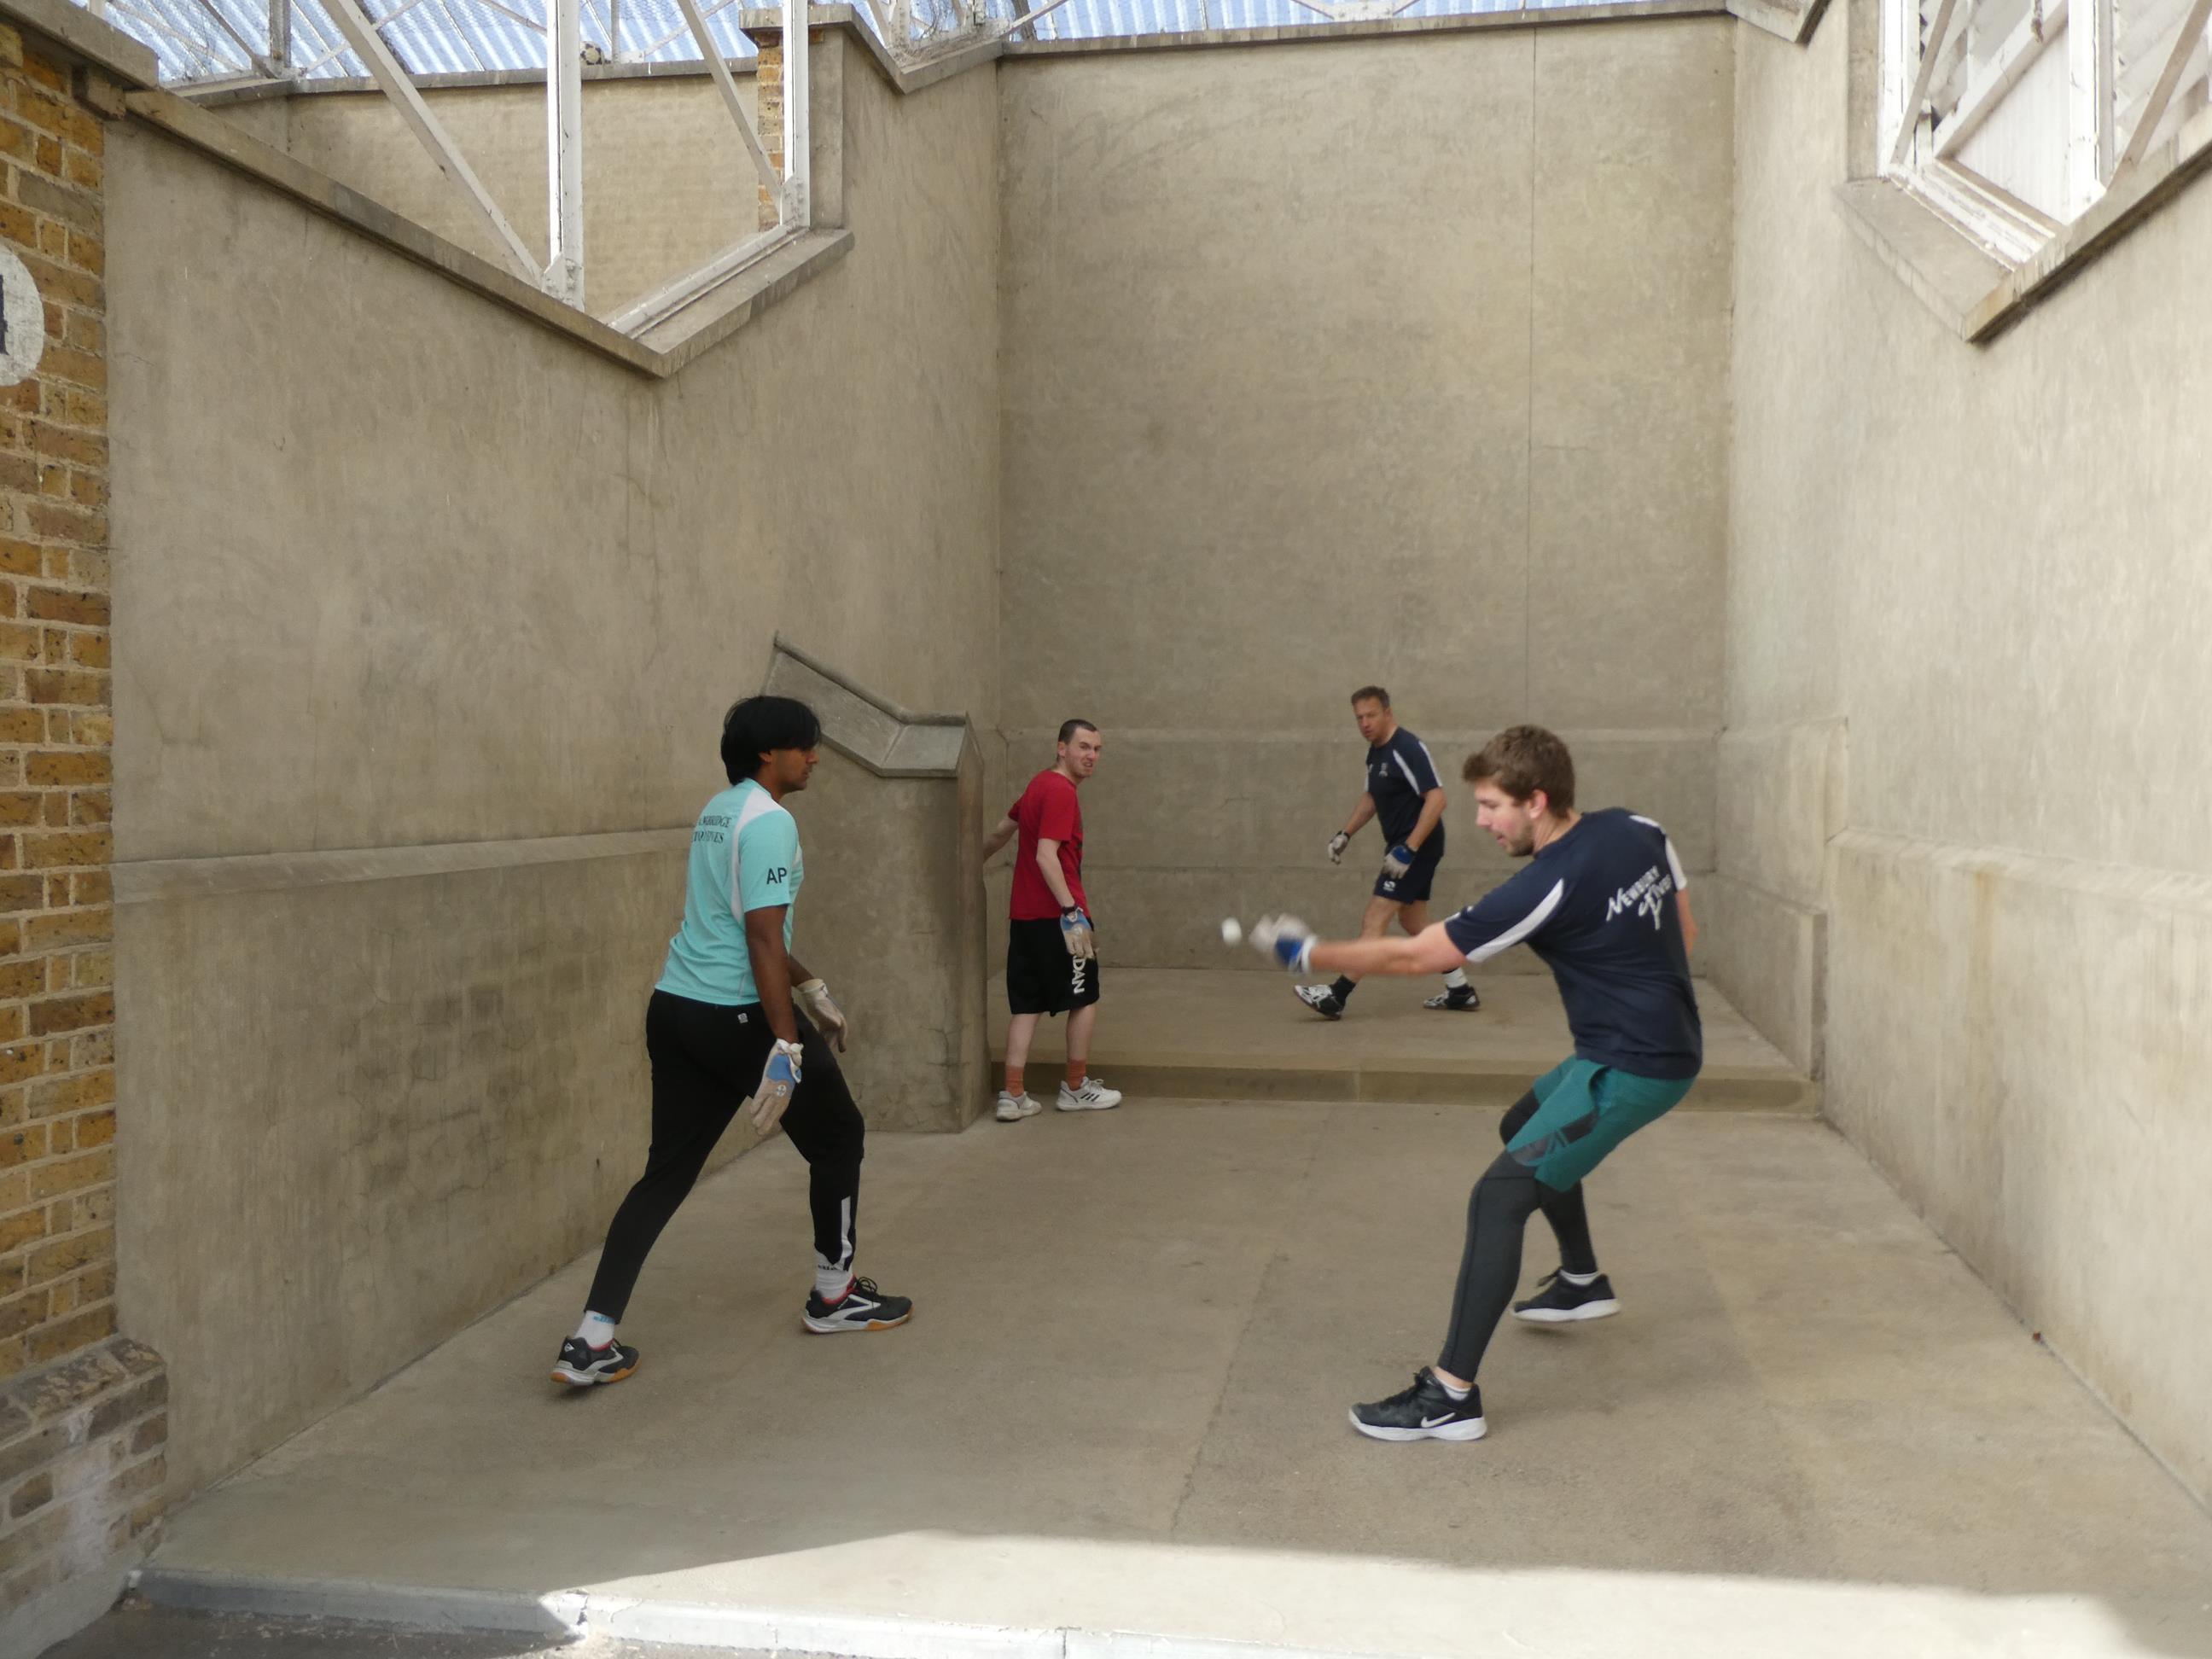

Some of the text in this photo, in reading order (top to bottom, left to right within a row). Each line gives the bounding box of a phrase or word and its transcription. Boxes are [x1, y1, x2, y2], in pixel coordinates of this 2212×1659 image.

[766, 867, 787, 884] AP
[1606, 864, 1660, 922] NEWBURY
[1072, 955, 1086, 994] DAN
